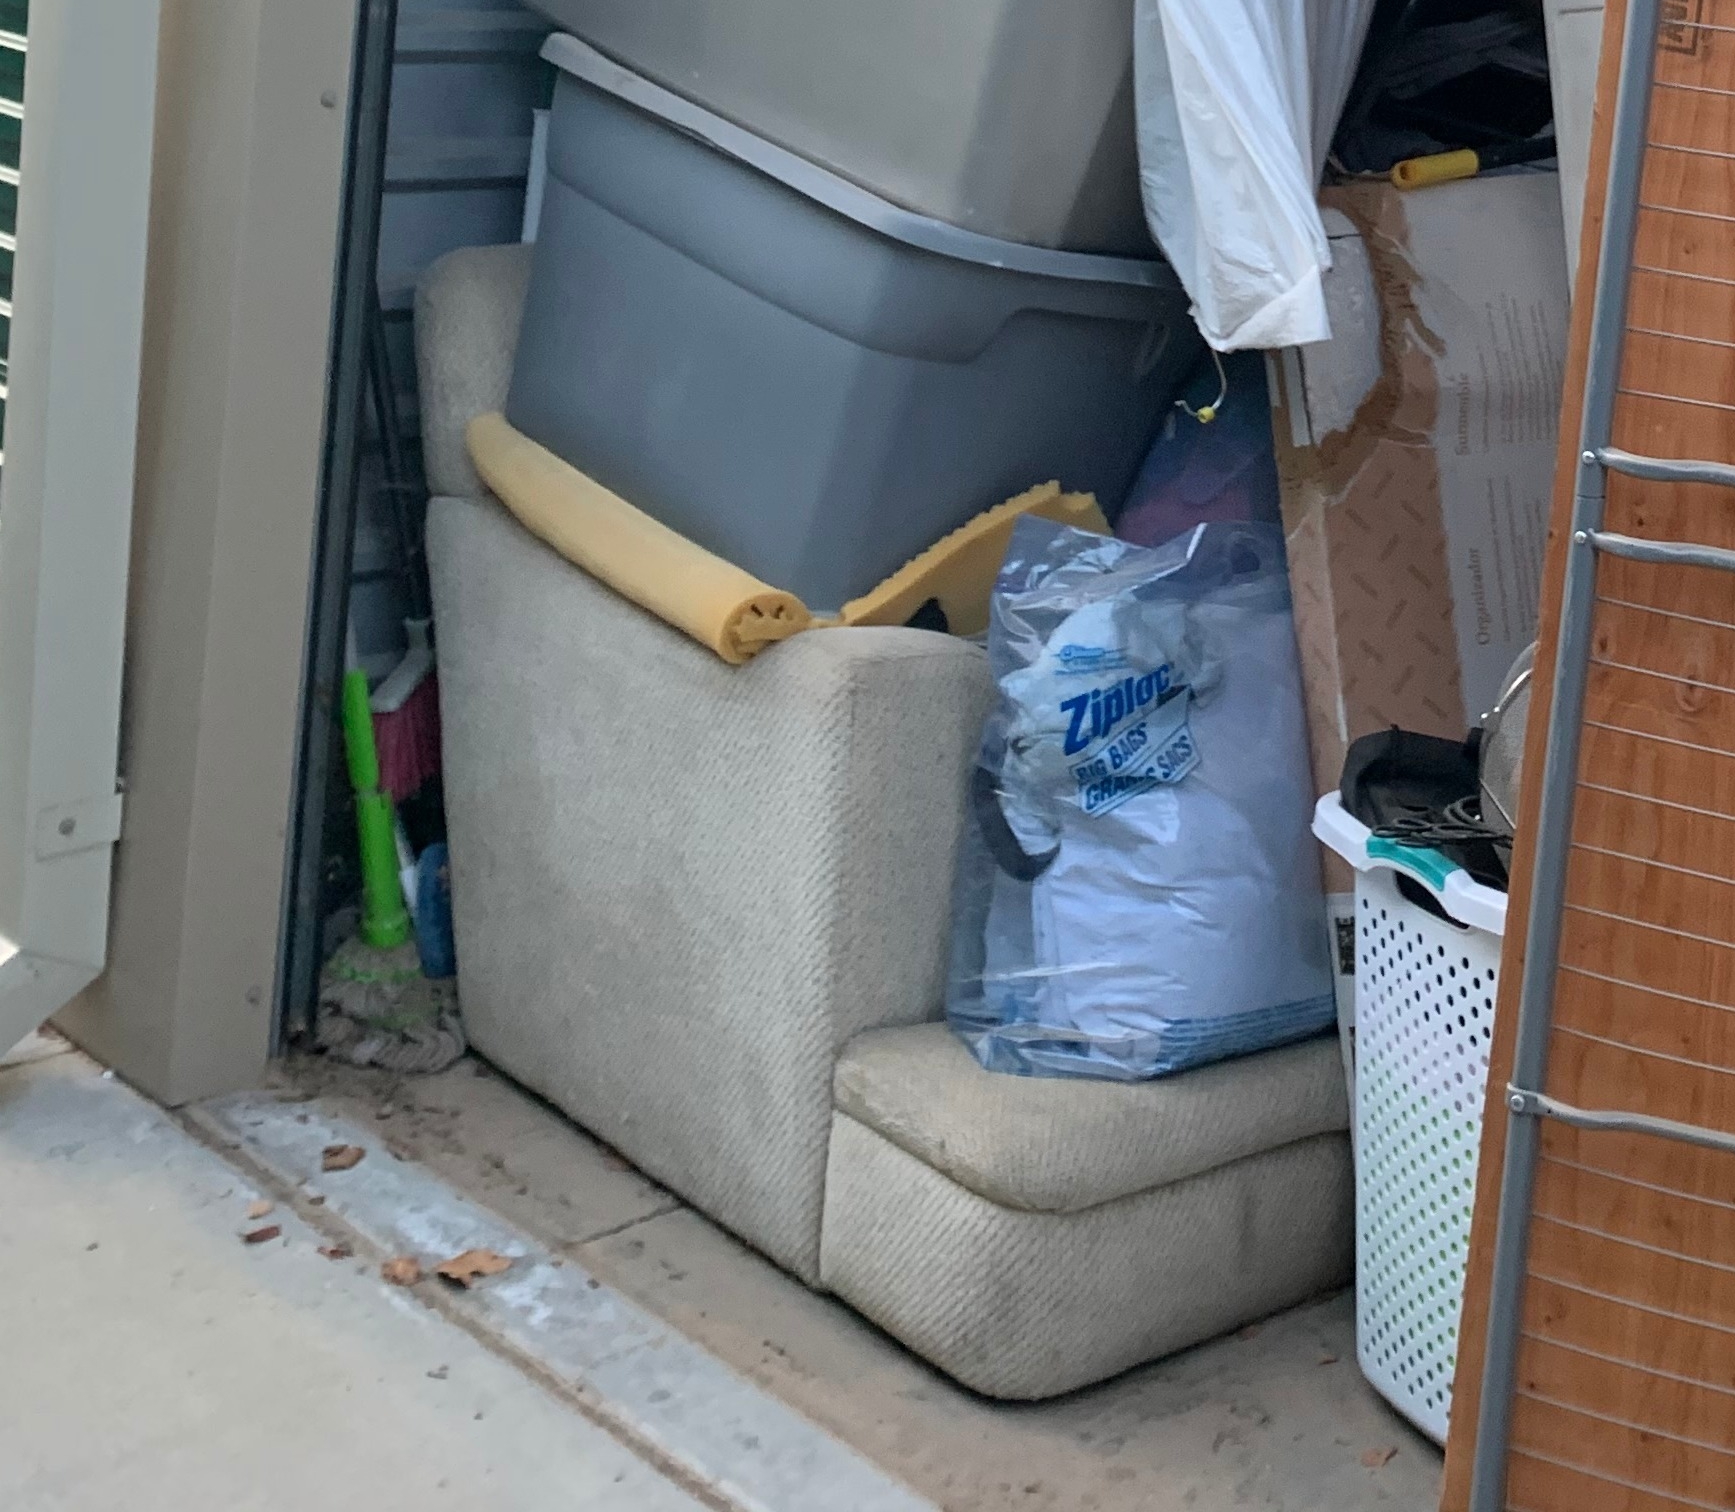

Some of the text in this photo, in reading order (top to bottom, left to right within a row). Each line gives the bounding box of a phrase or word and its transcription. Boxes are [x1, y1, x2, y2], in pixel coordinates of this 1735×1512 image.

[1060, 663, 1170, 756] Ziploc
[1108, 721, 1148, 770] BAGS
[1157, 734, 1193, 779] SACS
